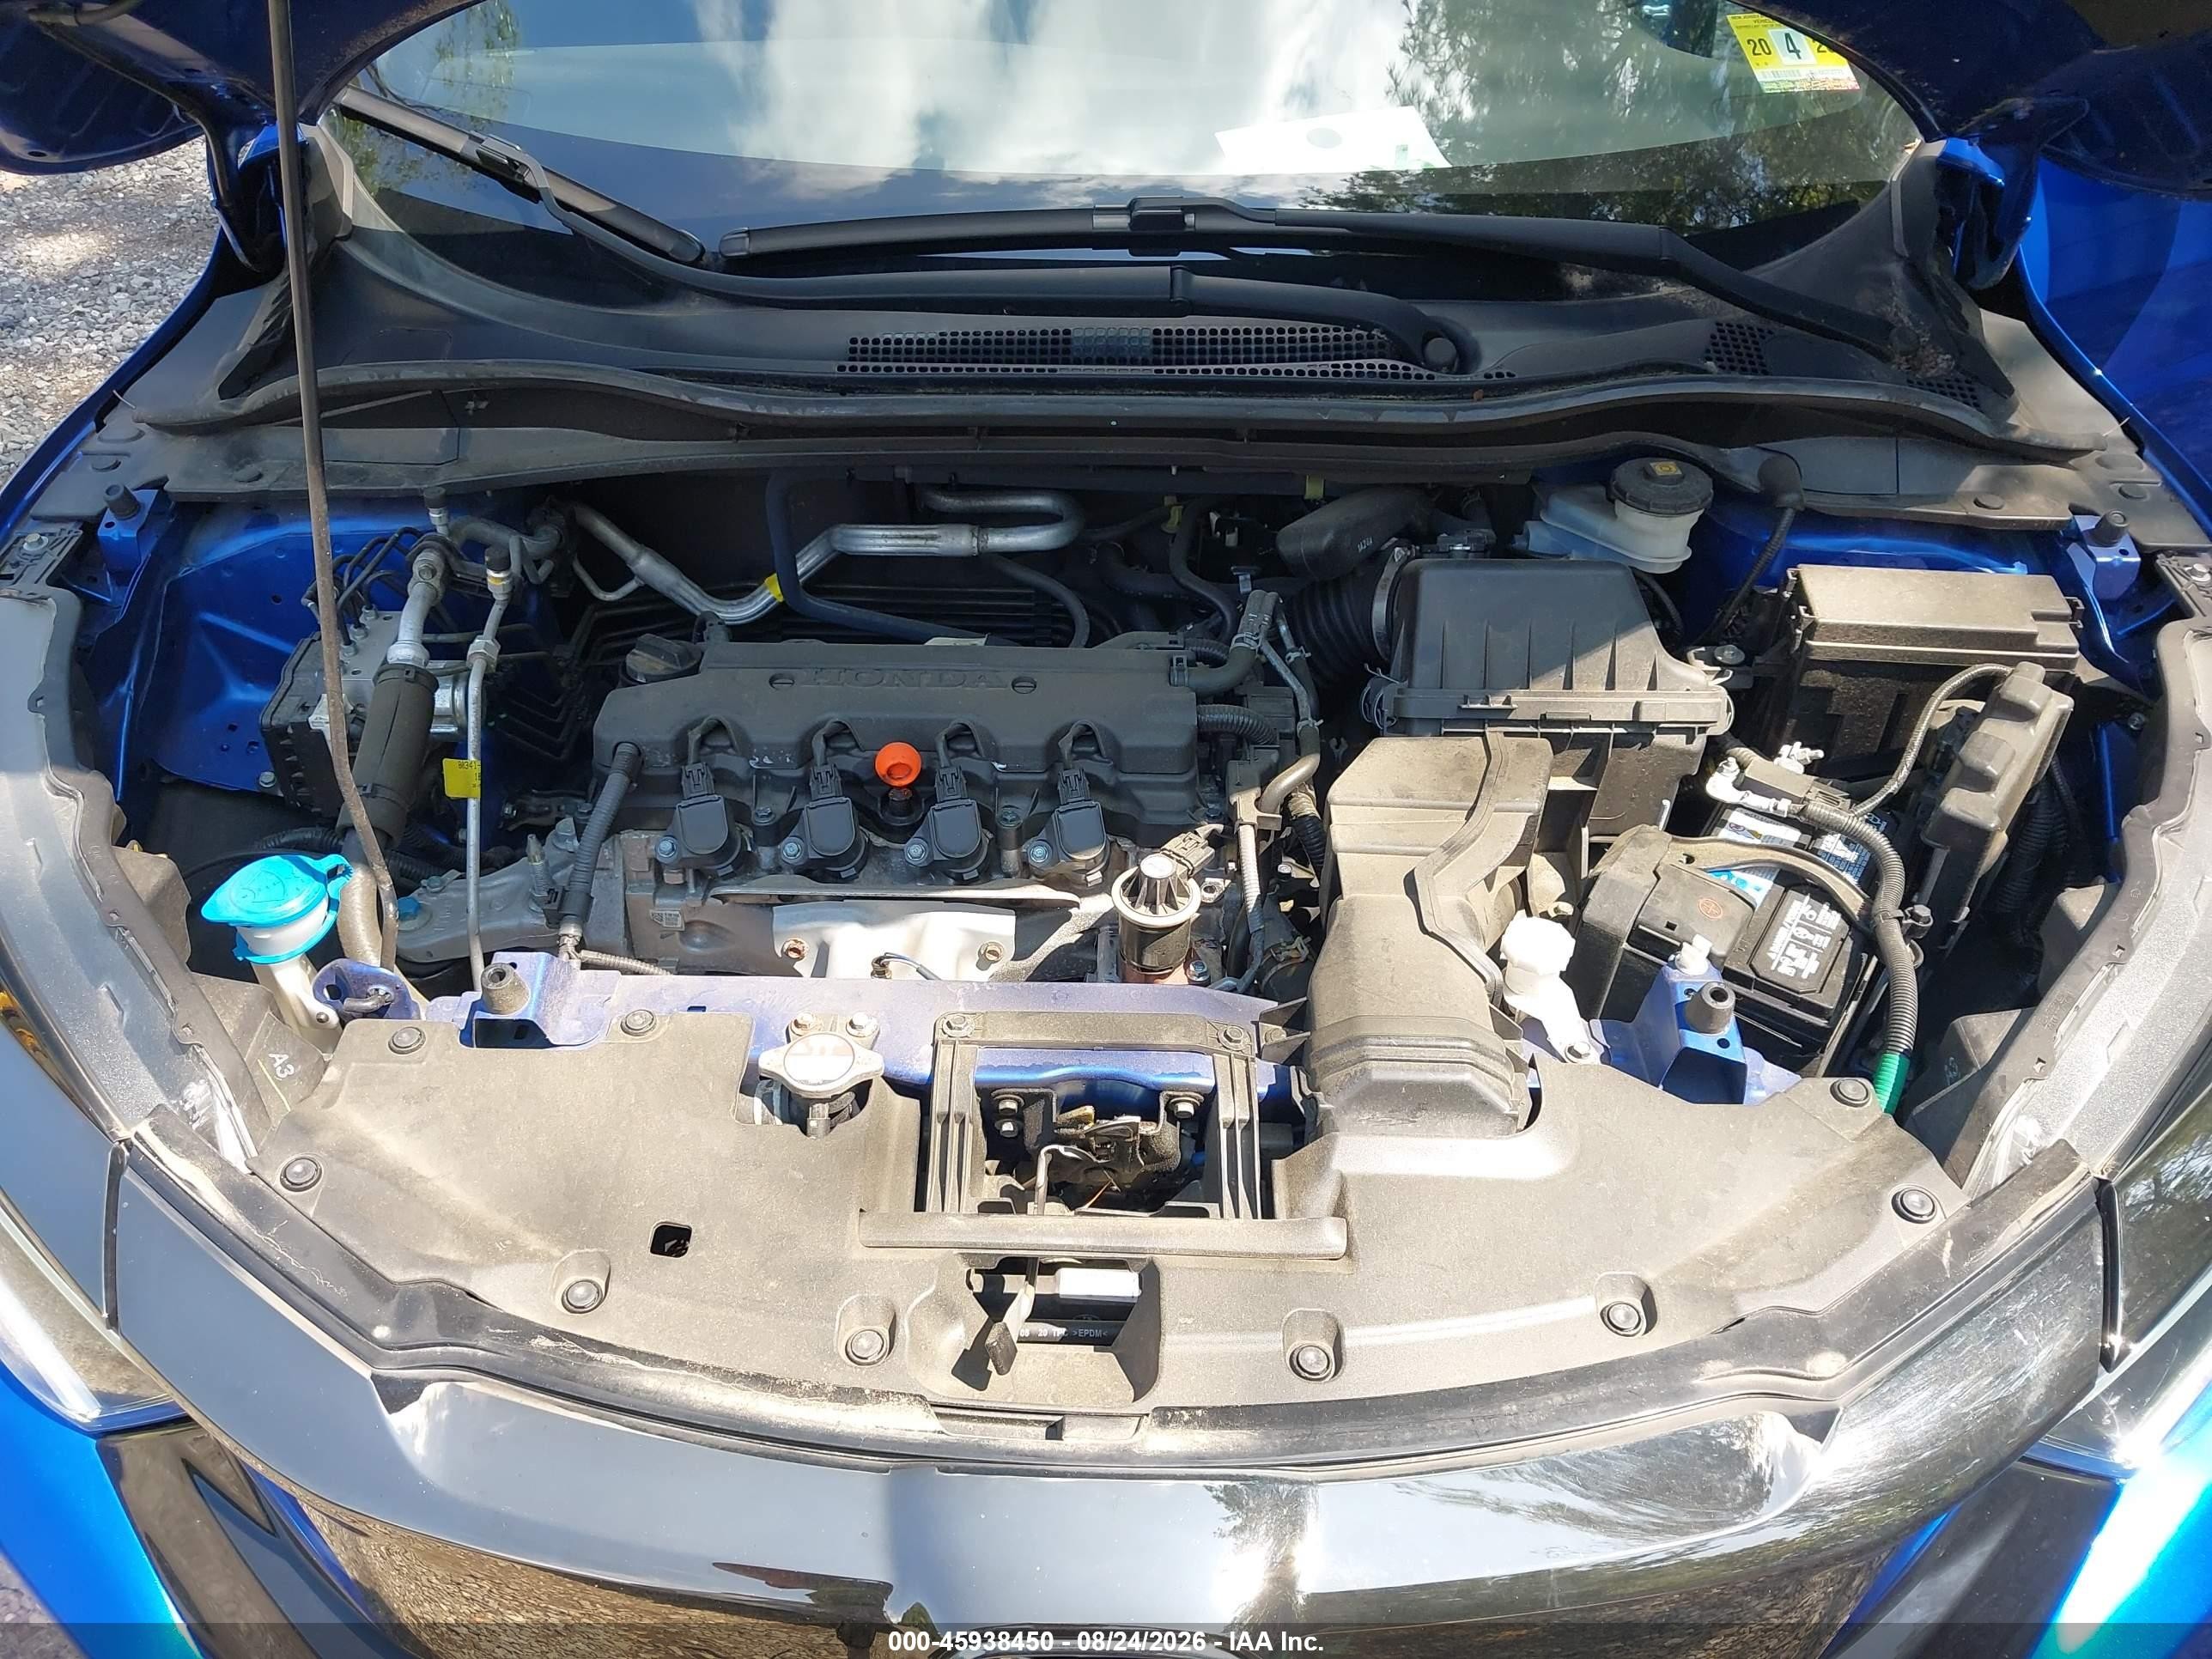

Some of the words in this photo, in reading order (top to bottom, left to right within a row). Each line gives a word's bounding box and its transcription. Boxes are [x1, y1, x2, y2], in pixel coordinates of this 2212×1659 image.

[1747, 38, 1772, 56] 20
[1784, 33, 1802, 59] 4
[1812, 39, 1835, 53] 2
[801, 668, 1007, 689] HONDA
[268, 1053, 295, 1079] A3
